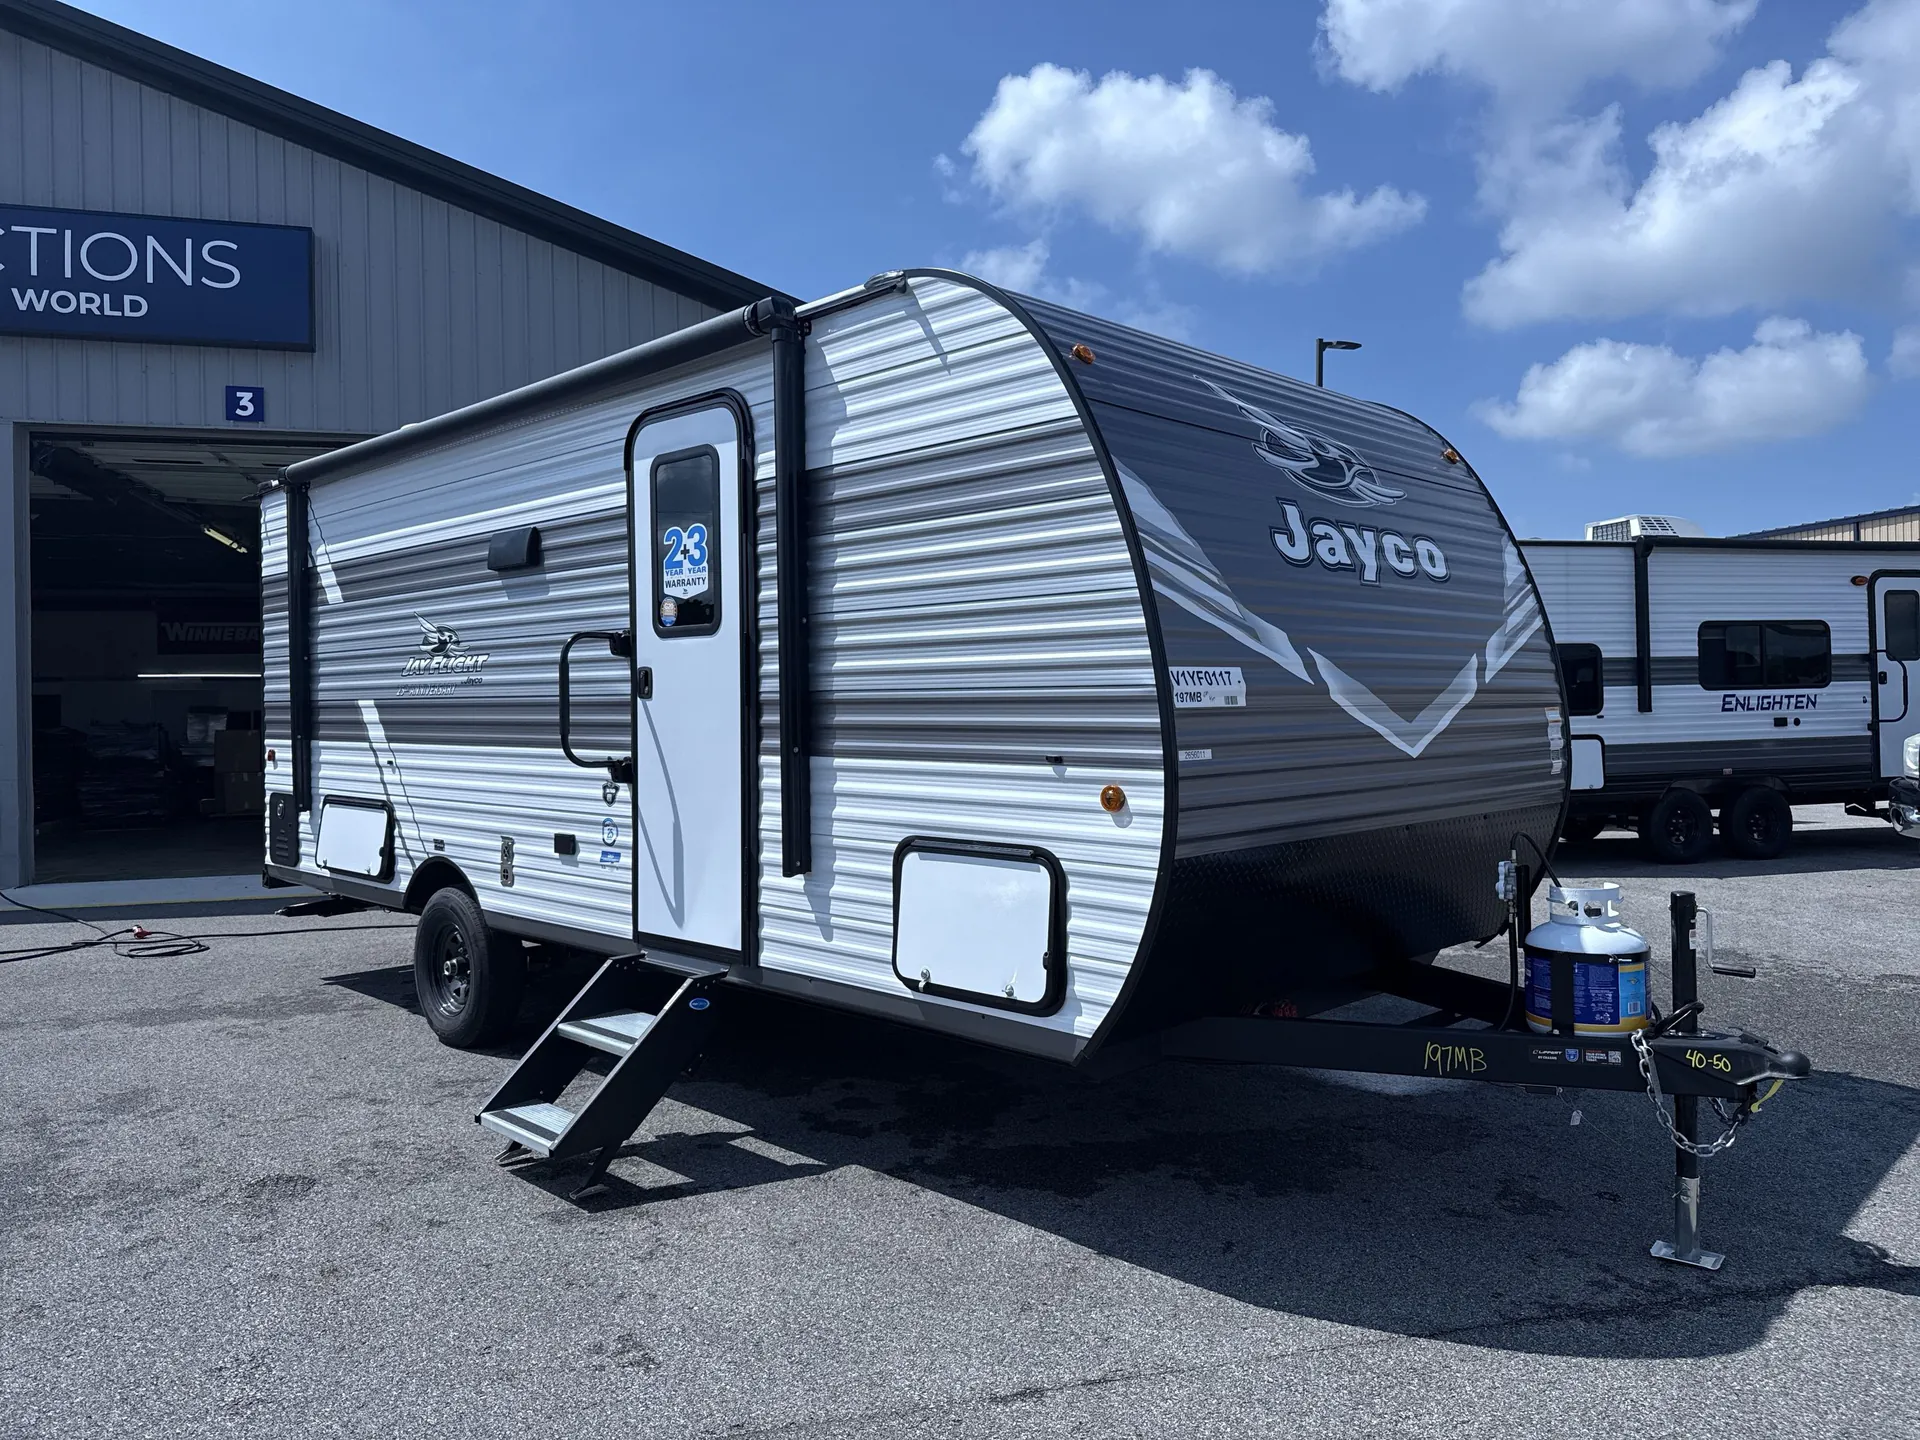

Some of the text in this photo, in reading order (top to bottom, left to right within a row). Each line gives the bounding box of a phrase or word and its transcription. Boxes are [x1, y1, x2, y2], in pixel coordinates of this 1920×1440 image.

[0, 225, 242, 289] TIONS
[11, 288, 149, 317] WORLD
[235, 391, 255, 417] 3
[1269, 497, 1451, 587] Jayco
[664, 576, 707, 589] WARRANTY
[665, 565, 707, 577] YEAR YEAR
[1170, 670, 1232, 687] V1YF0117
[1175, 691, 1203, 703] 197MB
[1720, 693, 1818, 713] ENLIGHTEN
[1423, 1041, 1488, 1076] 197MB
[1685, 1049, 1732, 1073] 40-50
